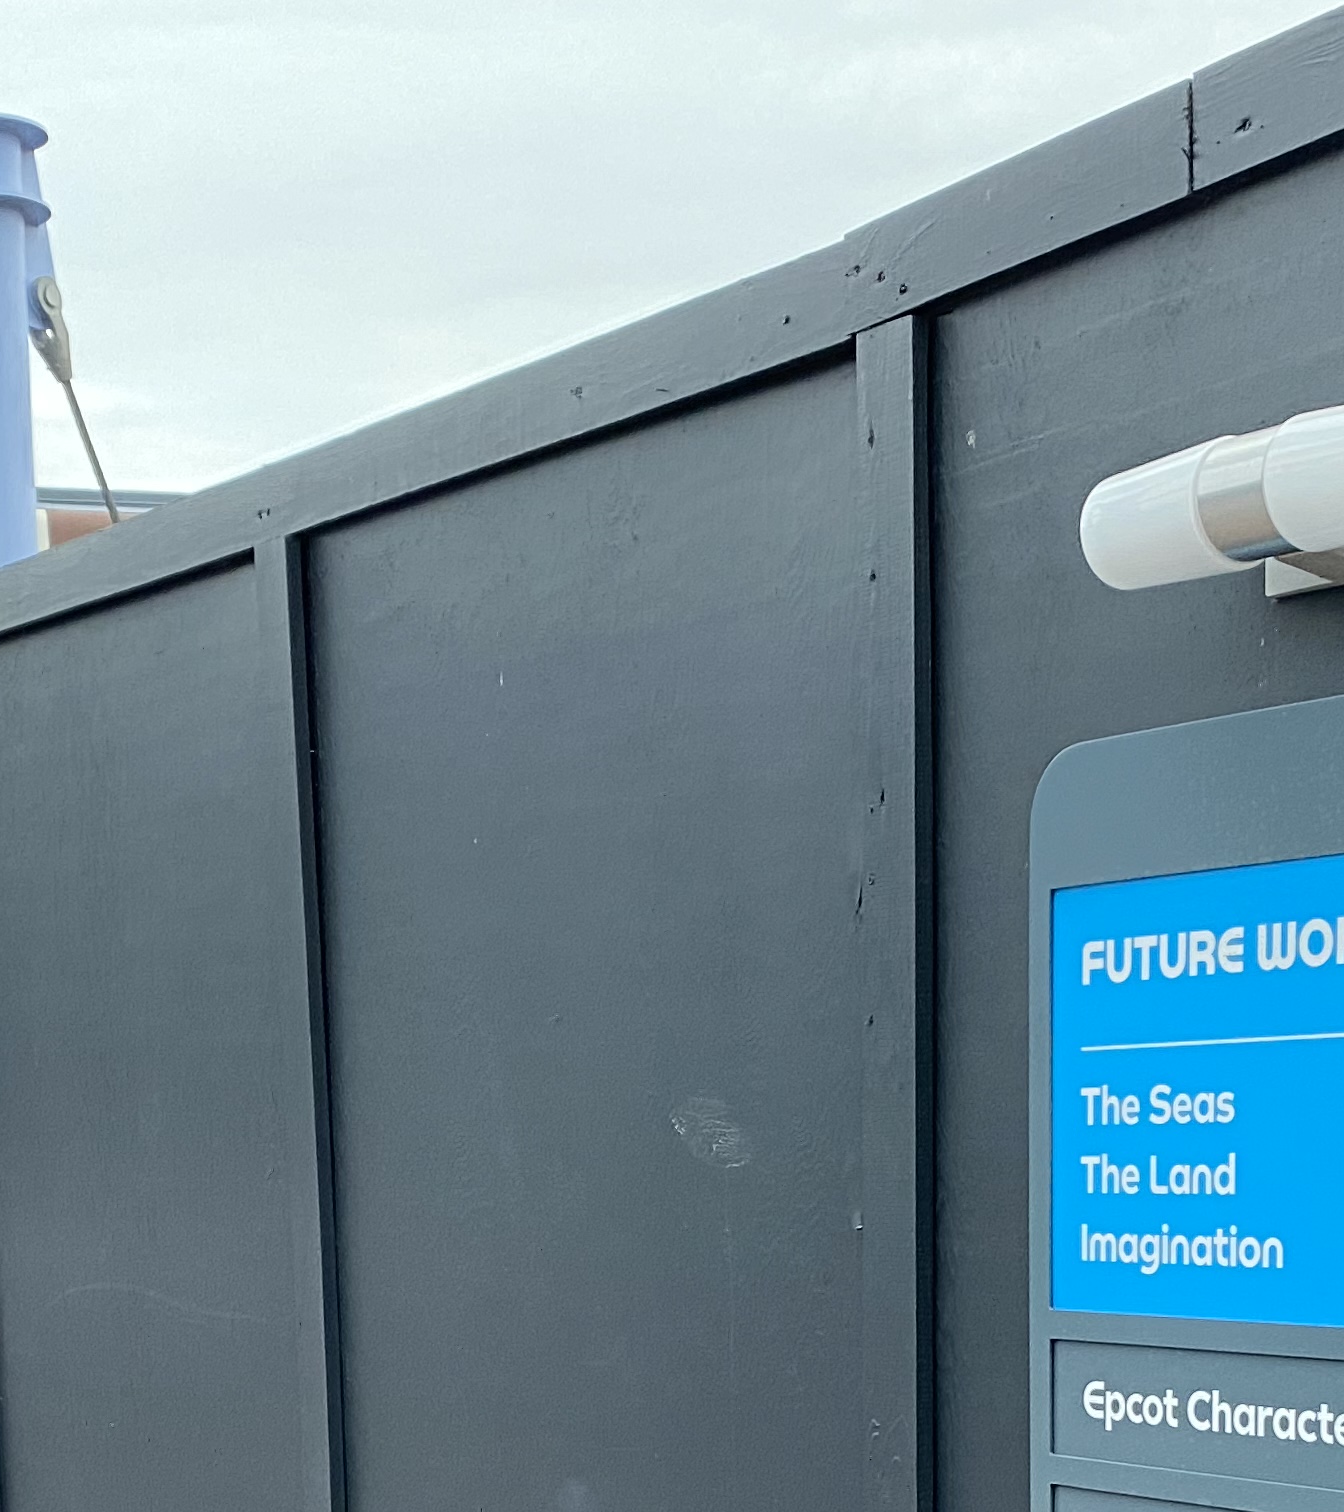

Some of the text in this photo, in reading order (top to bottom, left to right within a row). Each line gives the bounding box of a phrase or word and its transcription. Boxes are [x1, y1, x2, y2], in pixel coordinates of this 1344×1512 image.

[1081, 926, 1245, 986] FUTURE
[1080, 1084, 1236, 1127] The Seas
[1080, 1152, 1237, 1196] The Land
[1080, 1223, 1285, 1276] Imagination
[1082, 1379, 1179, 1432] Epcot
